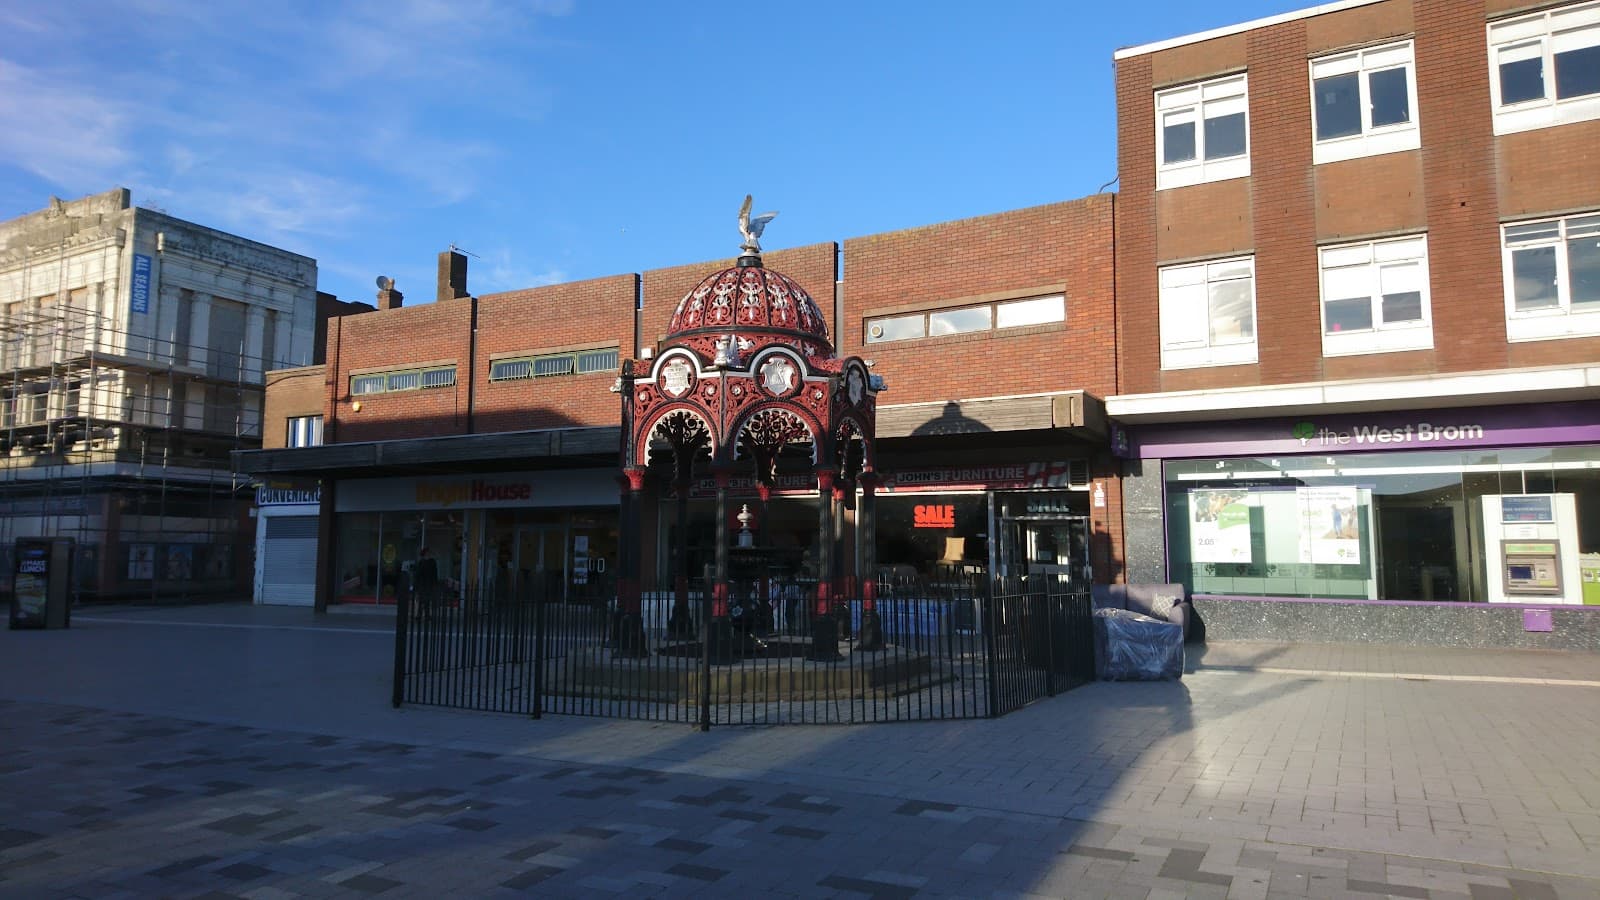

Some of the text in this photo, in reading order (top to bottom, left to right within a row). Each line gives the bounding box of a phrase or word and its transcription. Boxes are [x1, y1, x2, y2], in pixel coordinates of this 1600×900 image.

[132, 255, 149, 312] ALL SEASONS
[1318, 422, 1483, 446] the West Brom
[896, 467, 1024, 481] JOHN'S FURNITURE
[913, 505, 955, 523] SALE
